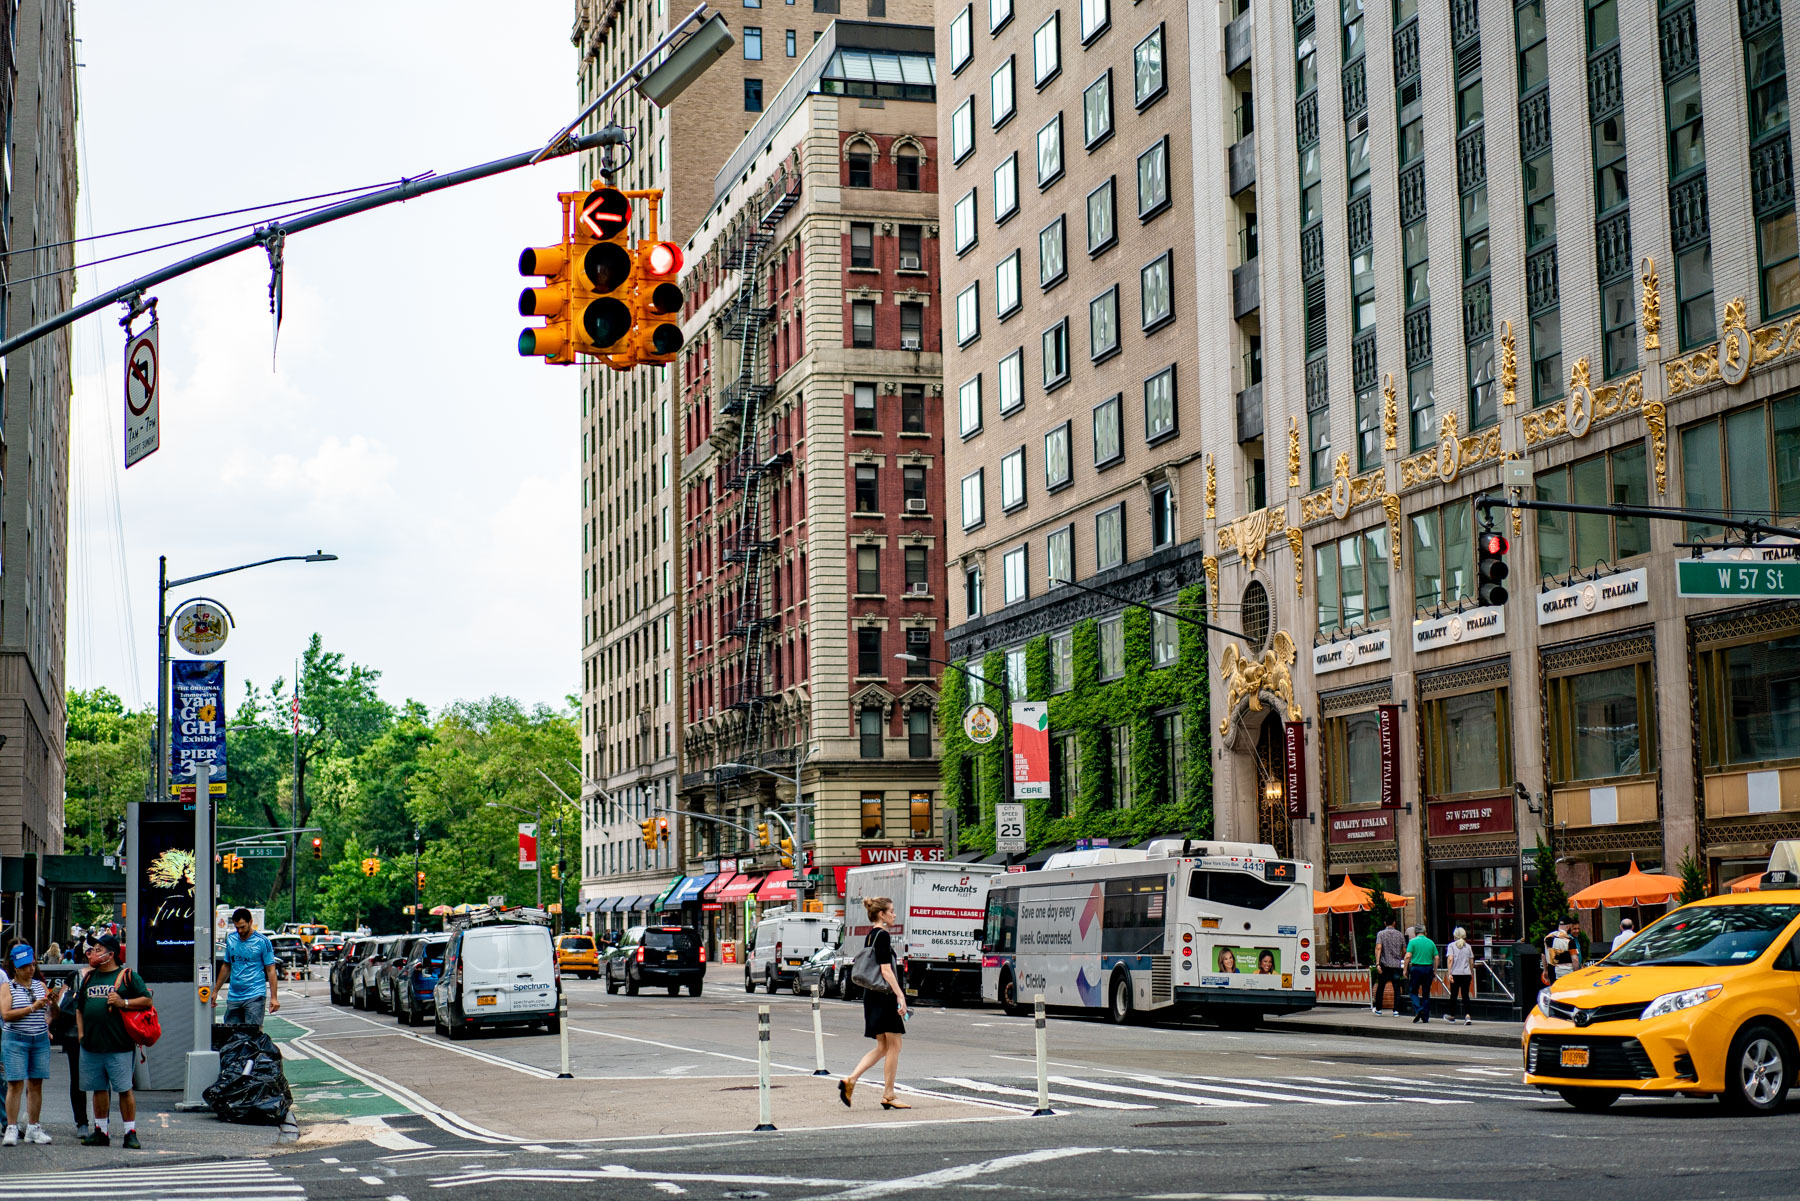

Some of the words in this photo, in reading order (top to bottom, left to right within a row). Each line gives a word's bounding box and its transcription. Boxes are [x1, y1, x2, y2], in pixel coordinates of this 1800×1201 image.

[1762, 547, 1794, 560] ITALI
[1718, 568, 1731, 589] W
[1739, 568, 1759, 590] 57
[1767, 568, 1784, 590] St
[1543, 595, 1578, 614] QUALITY
[1602, 581, 1639, 600] ITALIAN
[1417, 626, 1447, 642] QUALITY
[1466, 614, 1498, 631] ITALIAN
[1316, 650, 1342, 665] QUALITY
[1358, 640, 1385, 656] ITALIAN
[180, 696, 217, 707] van
[181, 720, 217, 735] GH
[1381, 710, 1392, 757] QUALITY
[180, 748, 217, 759] PIER
[1287, 727, 1297, 770] QUALITY
[1383, 760, 1392, 803] ITALIAN
[1289, 773, 1298, 812] ITALIAN
[1445, 811, 1454, 821] 57
[1481, 808, 1492, 818] ST
[1001, 823, 1022, 837] 25
[1333, 820, 1360, 830] QUALITY
[1361, 817, 1388, 828] ITALIAN
[867, 850, 909, 863] WINE
[913, 849, 924, 861] &
[1242, 863, 1264, 871] 4413
[932, 884, 977, 894] Merchants
[1021, 905, 1034, 919] Save
[1035, 907, 1046, 918] one
[1047, 904, 1059, 922] day
[1059, 906, 1076, 920] every
[911, 929, 974, 937] MERCHANTSFLEE
[1020, 931, 1035, 945] week.
[1036, 930, 1073, 945] Guaranteed.
[513, 982, 548, 991] Spectrum
[1025, 974, 1047, 992] ClickUp
